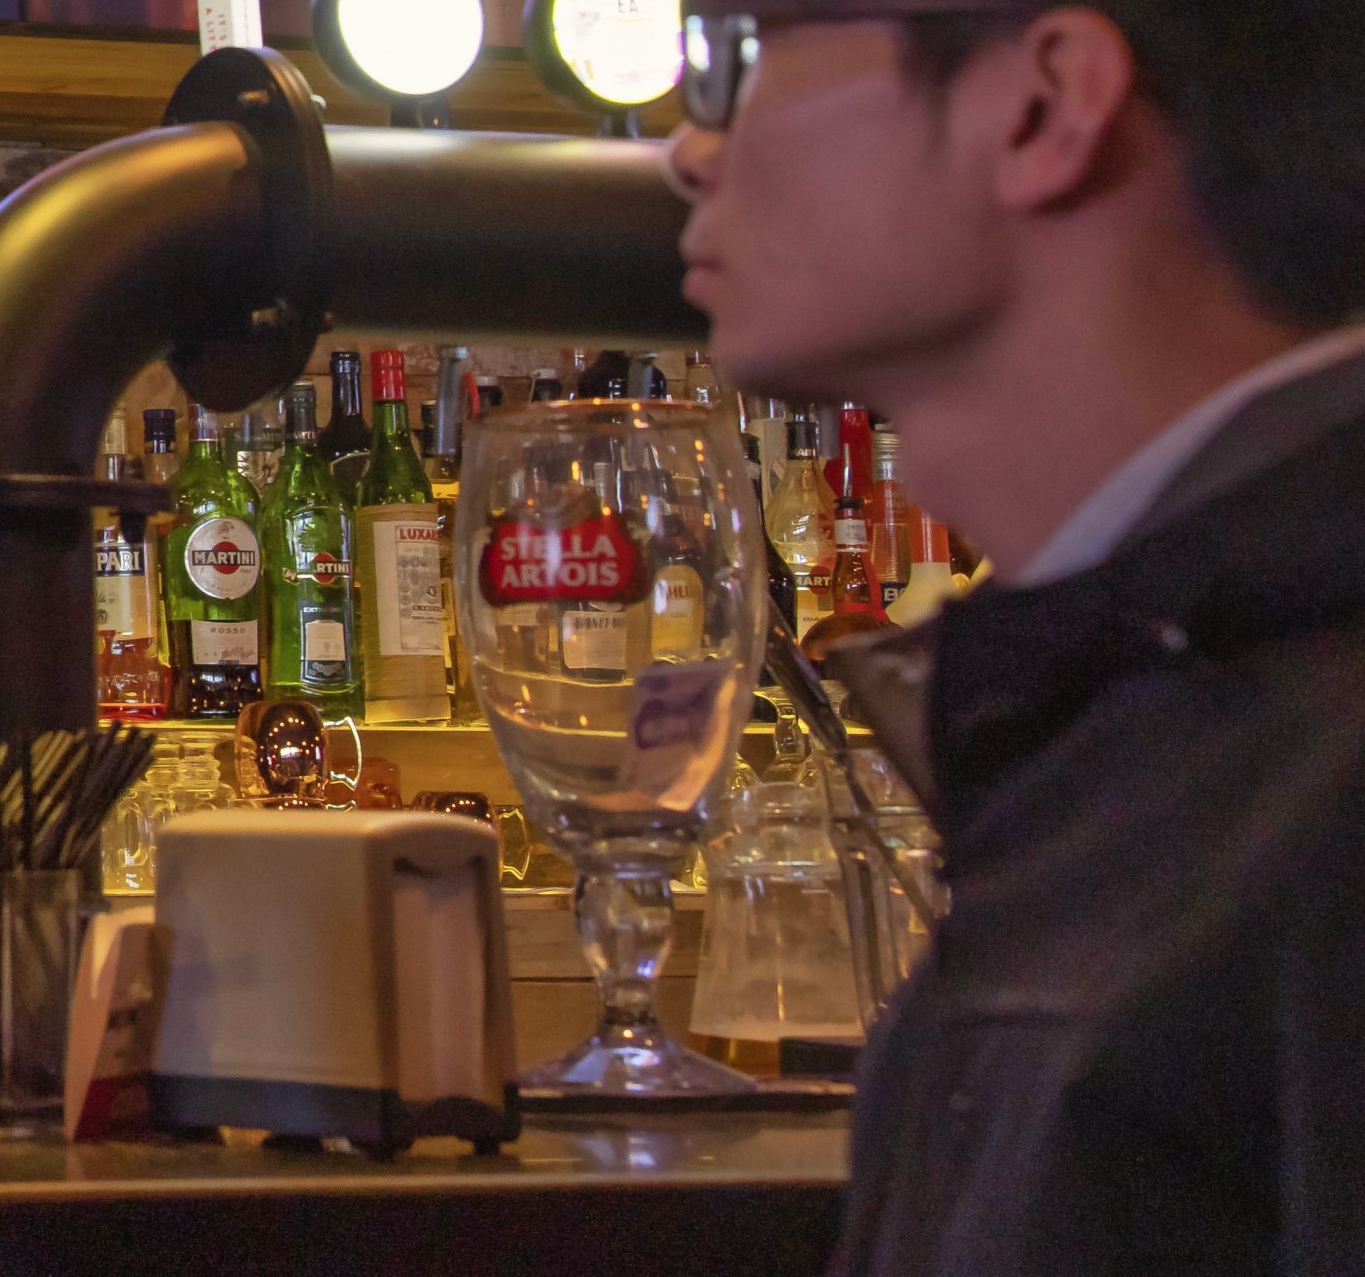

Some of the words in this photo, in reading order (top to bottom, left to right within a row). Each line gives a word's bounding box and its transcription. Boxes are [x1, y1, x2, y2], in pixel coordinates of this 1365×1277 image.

[194, 551, 254, 565] MARTINI
[500, 534, 617, 561] STELLA
[501, 561, 620, 588] ARTOIS
